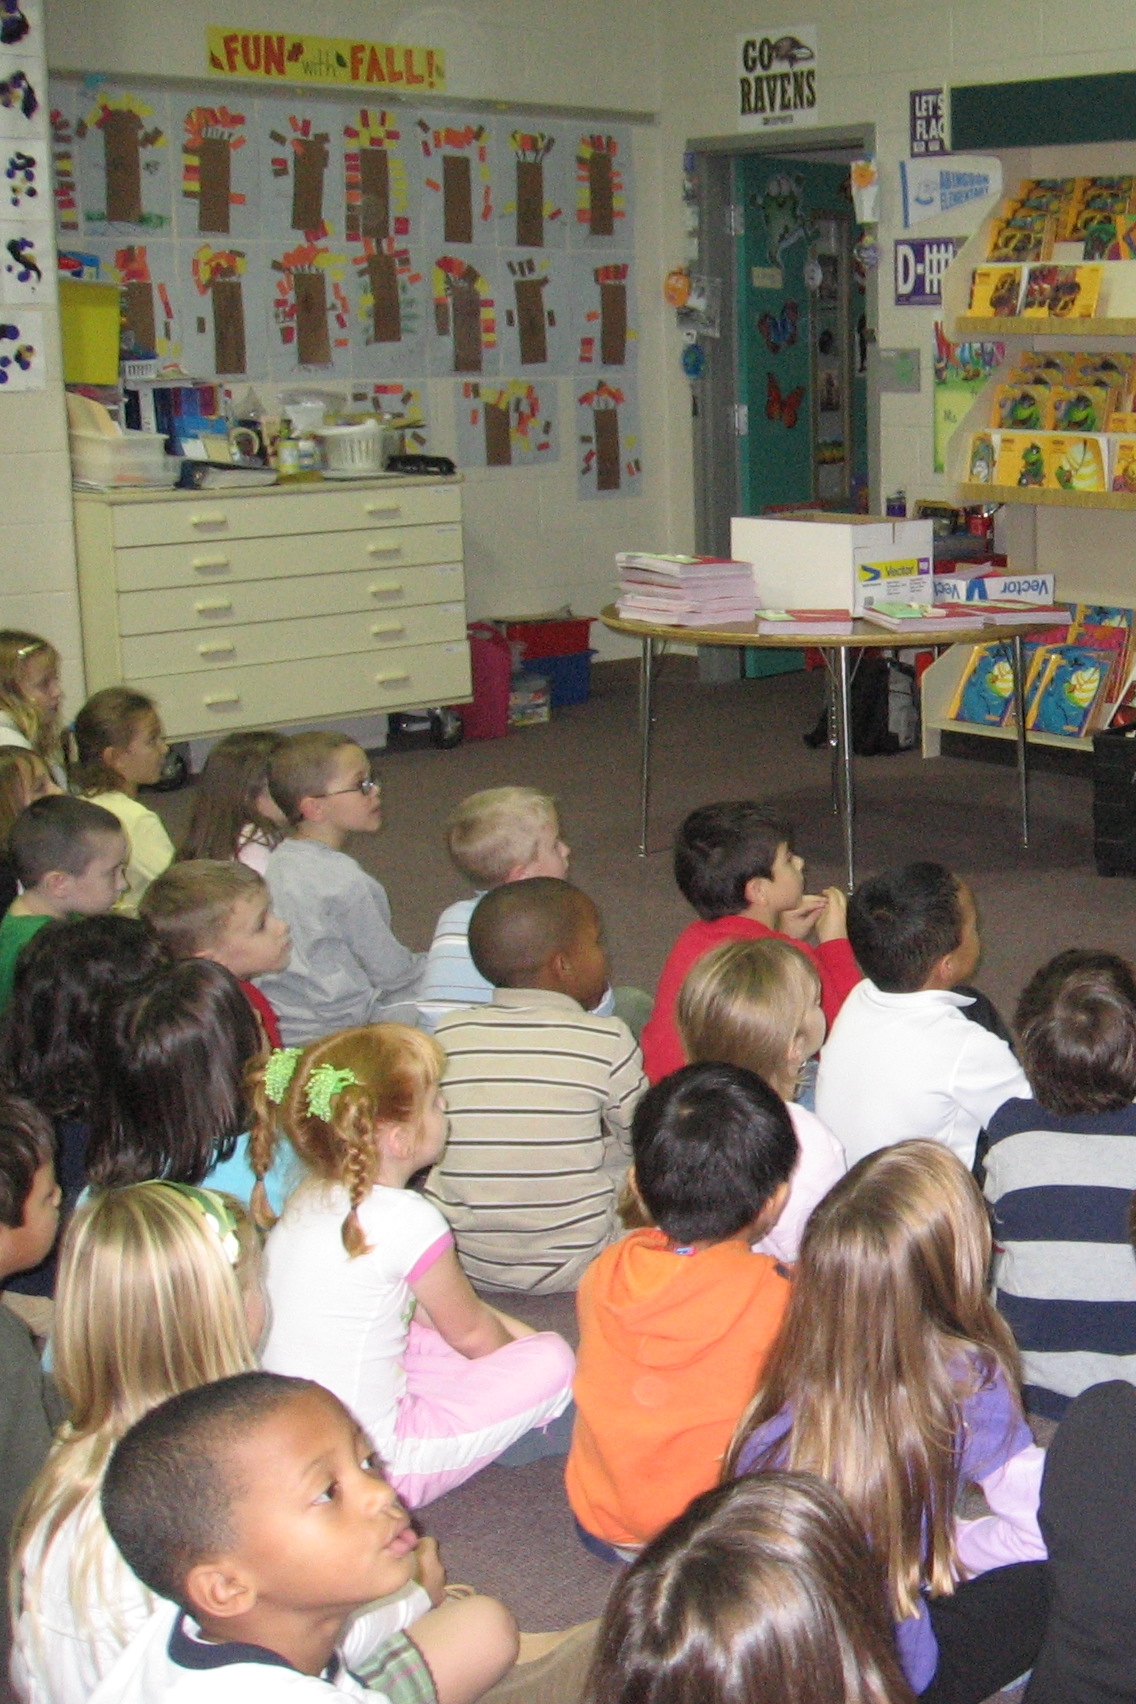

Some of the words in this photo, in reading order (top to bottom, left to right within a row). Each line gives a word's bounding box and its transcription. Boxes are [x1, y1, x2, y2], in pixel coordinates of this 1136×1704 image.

[223, 33, 286, 75] FUN
[302, 48, 336, 78] with
[351, 44, 435, 88] FALL!
[743, 37, 773, 72] GO
[740, 68, 816, 114] RAVENS
[885, 564, 915, 577] Vector
[1000, 578, 1049, 596] Vector
